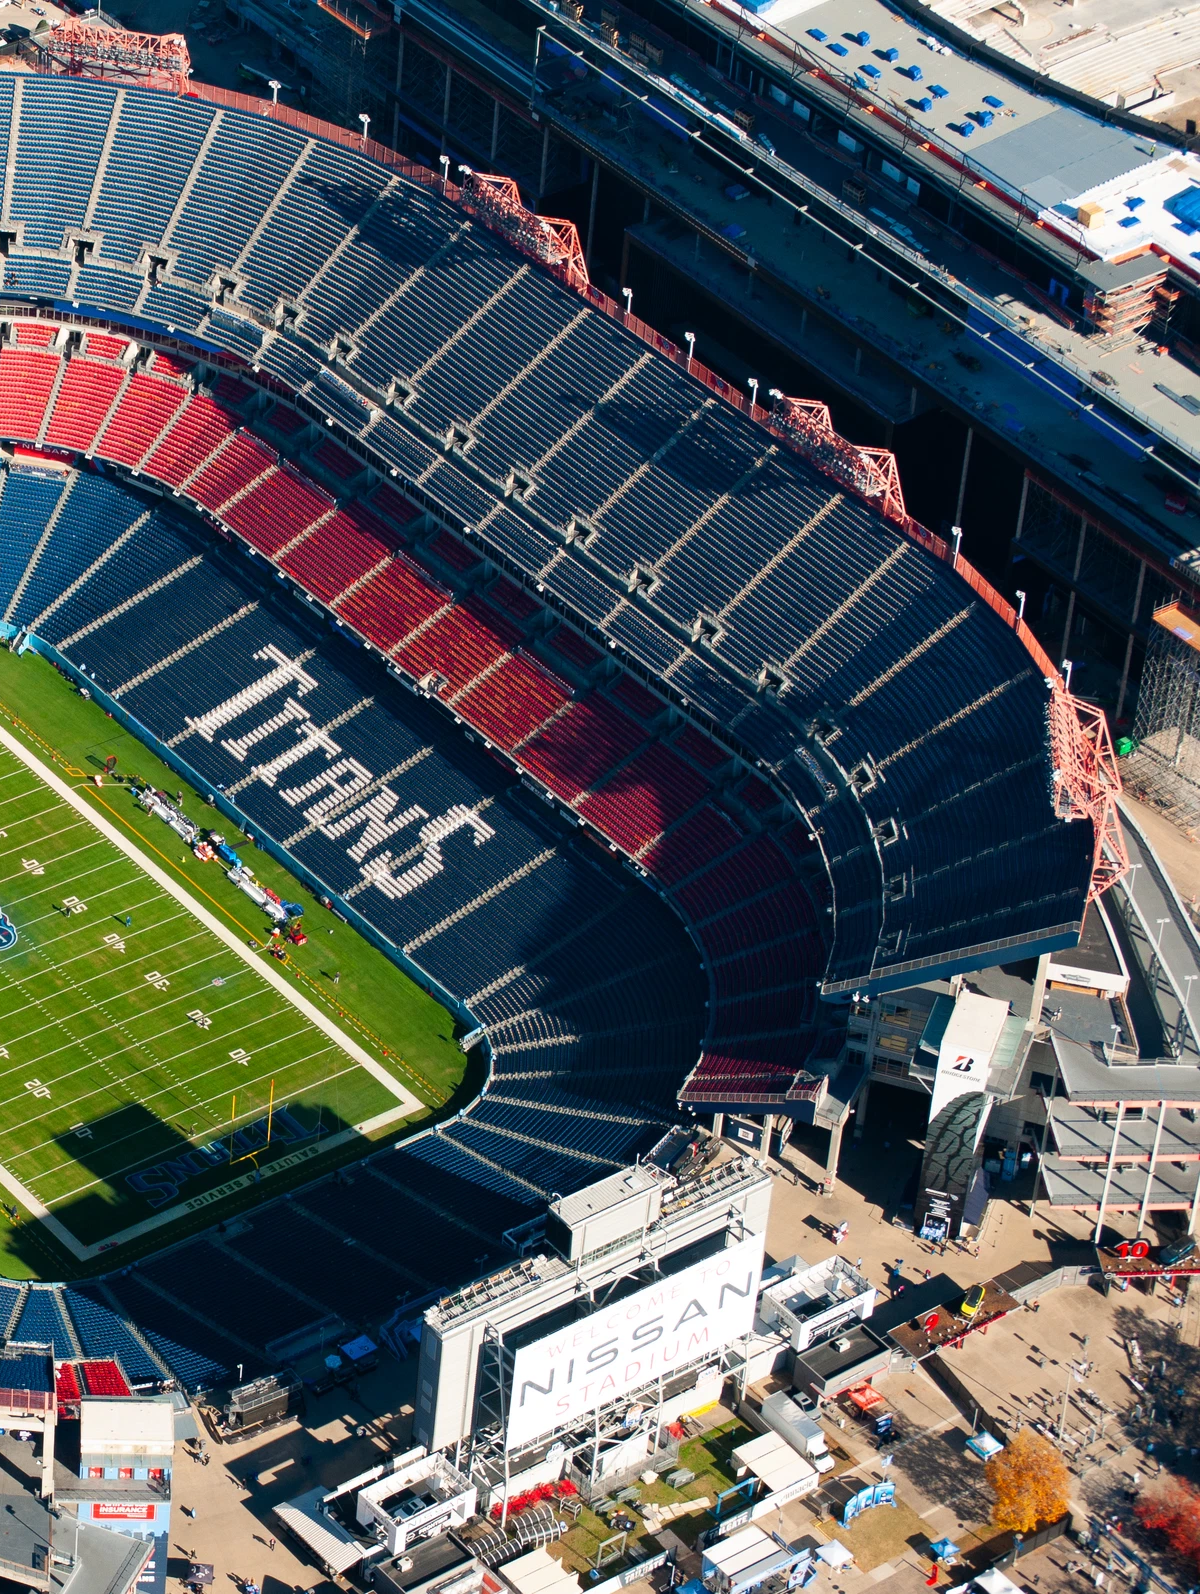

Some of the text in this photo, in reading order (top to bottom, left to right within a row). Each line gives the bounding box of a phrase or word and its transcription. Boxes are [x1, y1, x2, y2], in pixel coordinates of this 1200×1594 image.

[185, 643, 495, 899] TITANS
[23, 859, 45, 875] 40
[62, 895, 89, 914] 50
[103, 933, 126, 952] 40
[144, 971, 170, 990] 30
[228, 1048, 251, 1066] 10
[941, 1069, 981, 1083] BRIDGESTONE
[24, 1078, 50, 1098] 20
[125, 1103, 329, 1209] TITANS
[267, 1147, 320, 1176] SALUTE
[187, 1181, 244, 1211] SERVICE
[1116, 1240, 1149, 1258] 10
[547, 1260, 731, 1359] WELCOME TO
[923, 1312, 939, 1333] 9
[519, 1271, 753, 1408] NISSAN
[555, 1327, 709, 1416] STADIUM
[708, 1514, 750, 1539] TAILGATE
[624, 1560, 666, 1584] TAILGATE
